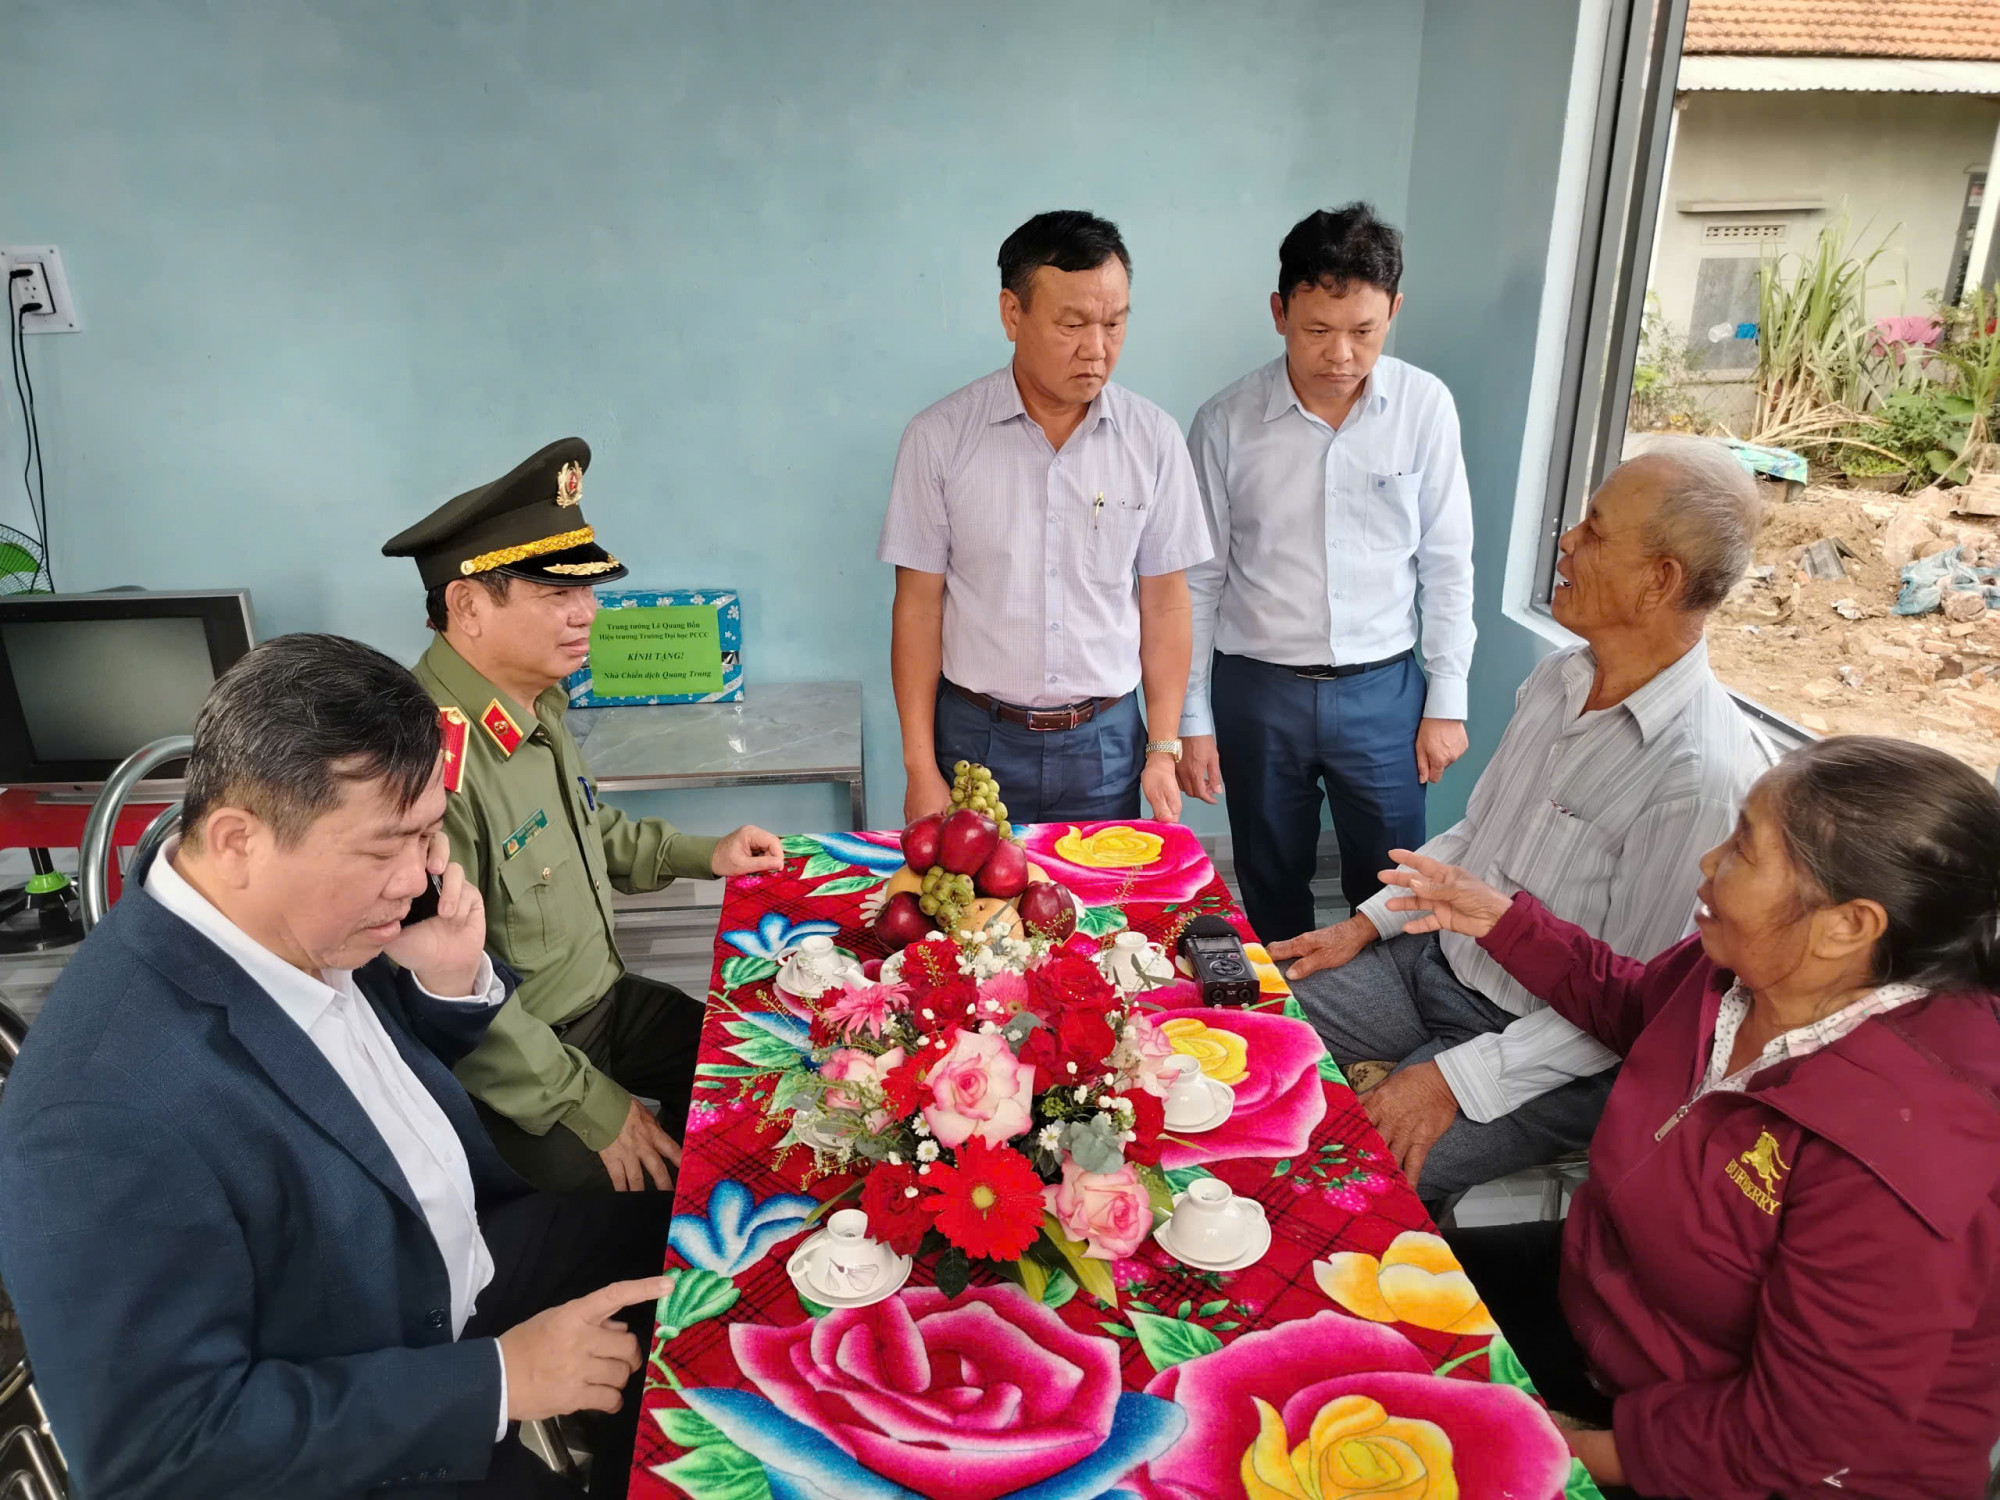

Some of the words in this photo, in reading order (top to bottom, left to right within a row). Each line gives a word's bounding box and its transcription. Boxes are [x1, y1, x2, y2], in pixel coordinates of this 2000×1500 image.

[607, 623, 629, 631] Trung
[630, 622, 650, 630] tướng
[651, 621, 660, 629] Lê
[662, 621, 685, 630] Quang
[599, 633, 614, 641] Hiệu
[677, 631, 688, 640] học
[627, 651, 652, 661] KÍNH
[644, 671, 660, 680] dịch
[662, 671, 687, 680] Quang
[689, 670, 712, 678] Trung
[1725, 1158, 1781, 1215] BURBERRY
